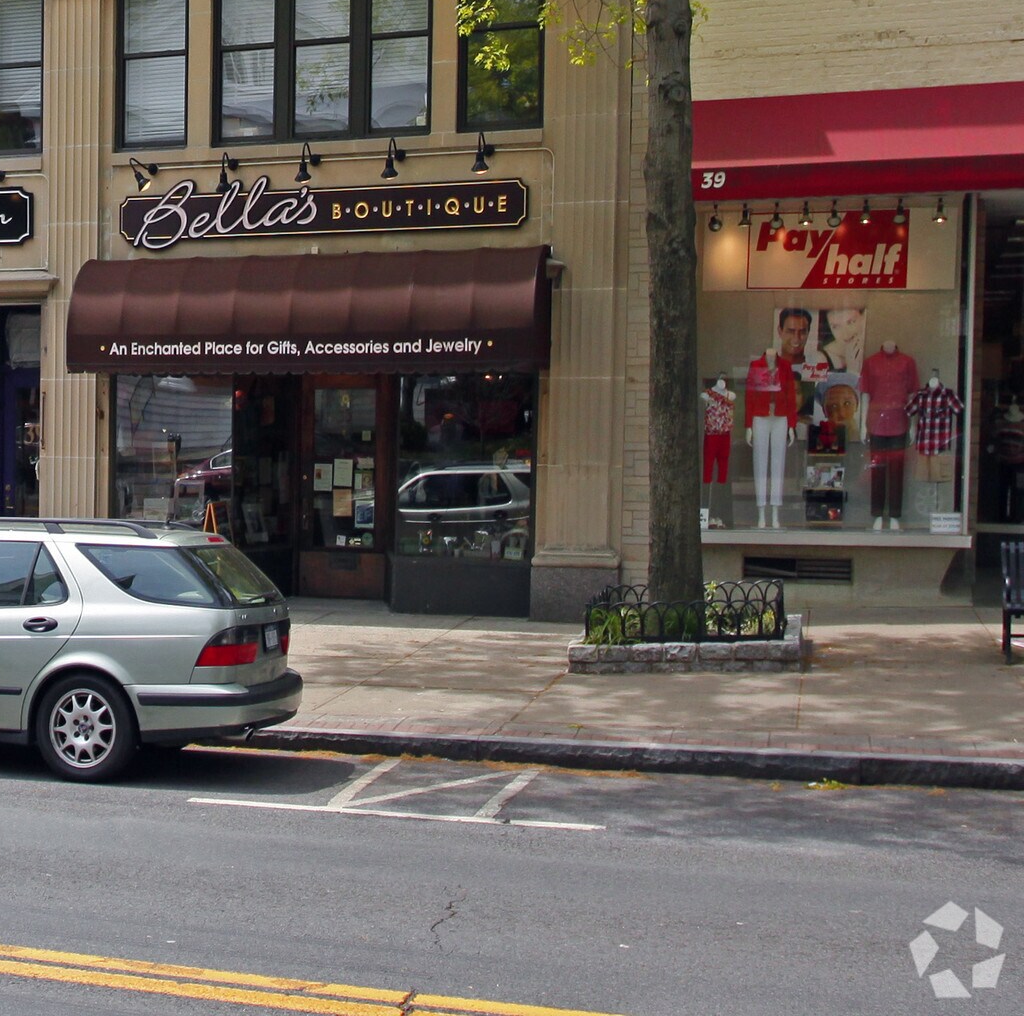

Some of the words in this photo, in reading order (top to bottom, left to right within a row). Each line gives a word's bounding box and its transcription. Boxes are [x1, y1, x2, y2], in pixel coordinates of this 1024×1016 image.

[701, 171, 726, 188] 39
[133, 175, 318, 250] Bella's
[756, 221, 834, 258] Pay
[824, 243, 902, 275] half
[109, 342, 127, 356] An
[131, 342, 201, 356] Enchanted
[204, 341, 242, 355] Place
[246, 341, 264, 354] for
[267, 340, 301, 356] Gifts,
[304, 340, 390, 354] Accessories
[392, 339, 422, 354] and
[426, 338, 482, 355] Jewelry
